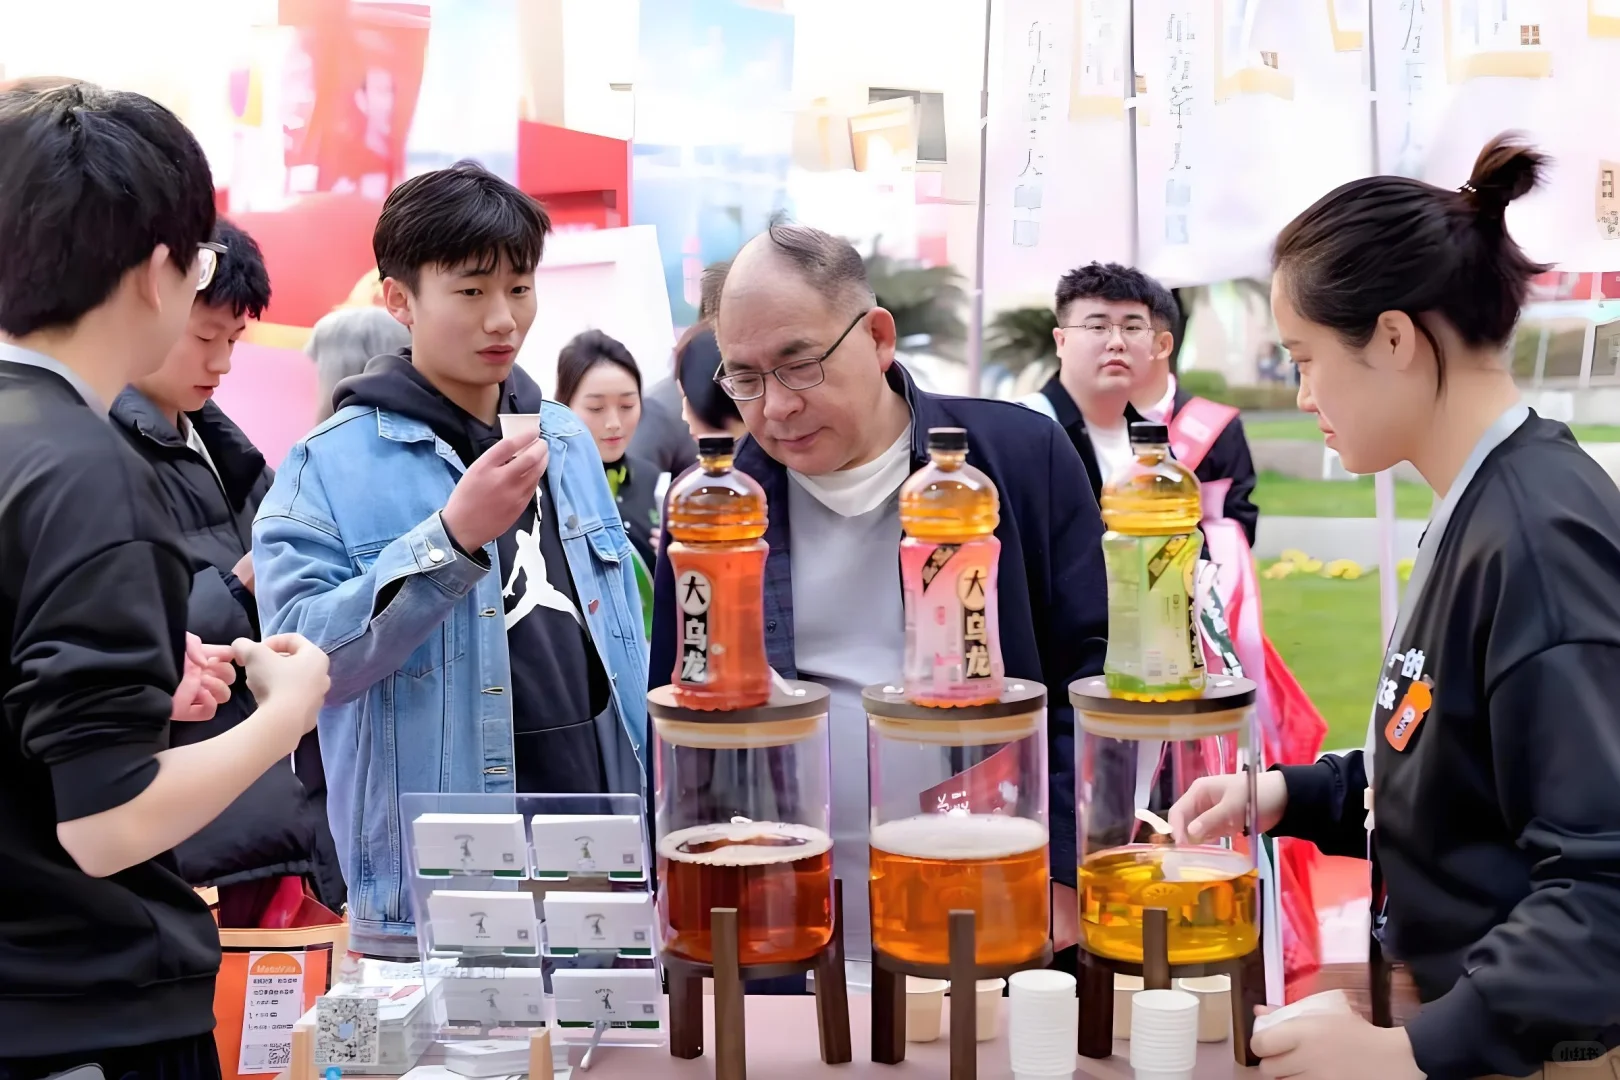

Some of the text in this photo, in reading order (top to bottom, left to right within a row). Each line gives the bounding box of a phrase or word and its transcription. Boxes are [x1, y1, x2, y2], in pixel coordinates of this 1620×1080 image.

[682, 574, 708, 682] 大乌龙
[963, 568, 992, 679] 大乌龙
